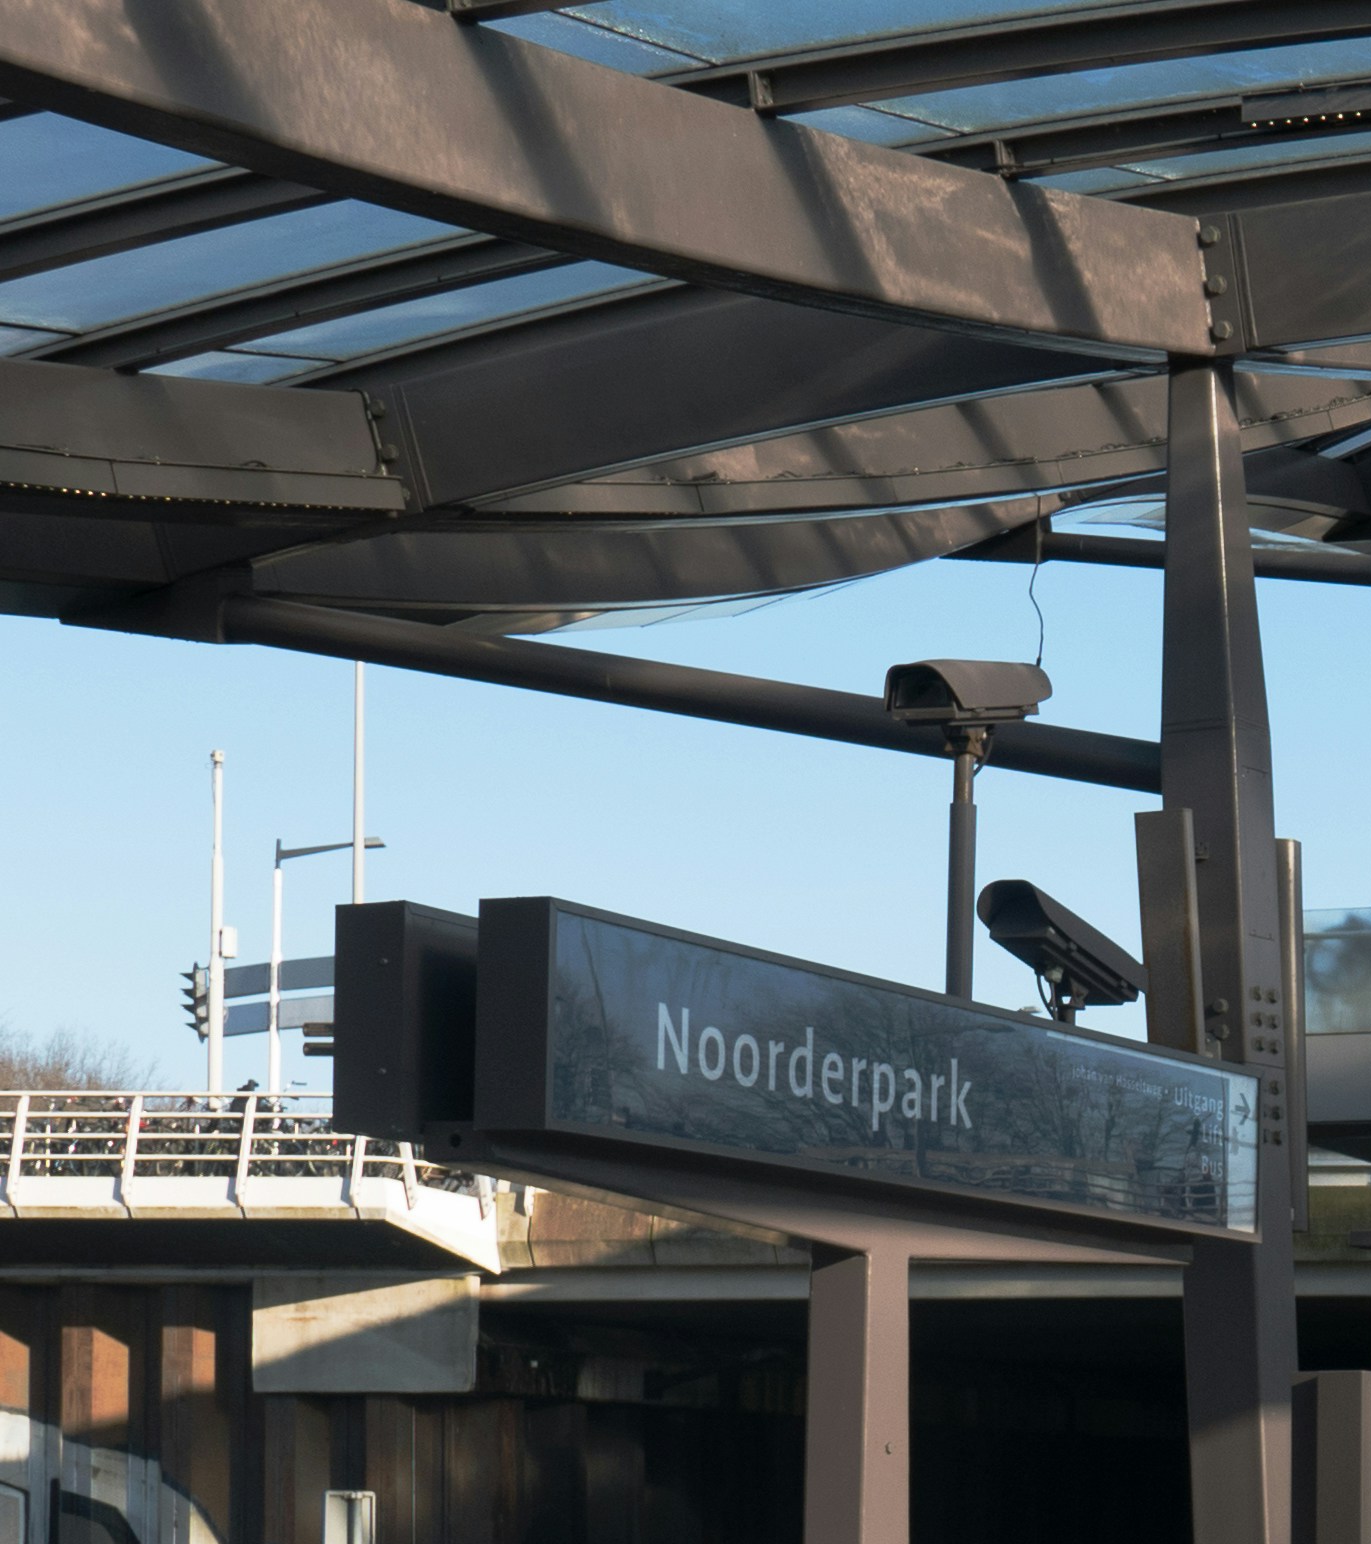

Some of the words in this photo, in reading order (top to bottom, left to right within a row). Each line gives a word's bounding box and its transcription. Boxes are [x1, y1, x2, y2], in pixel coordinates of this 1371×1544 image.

[656, 1001, 973, 1132] Noorderpark
[1174, 1086, 1224, 1120] Uitgang
[1202, 1124, 1224, 1147] Lift
[1201, 1155, 1224, 1178] Bus
